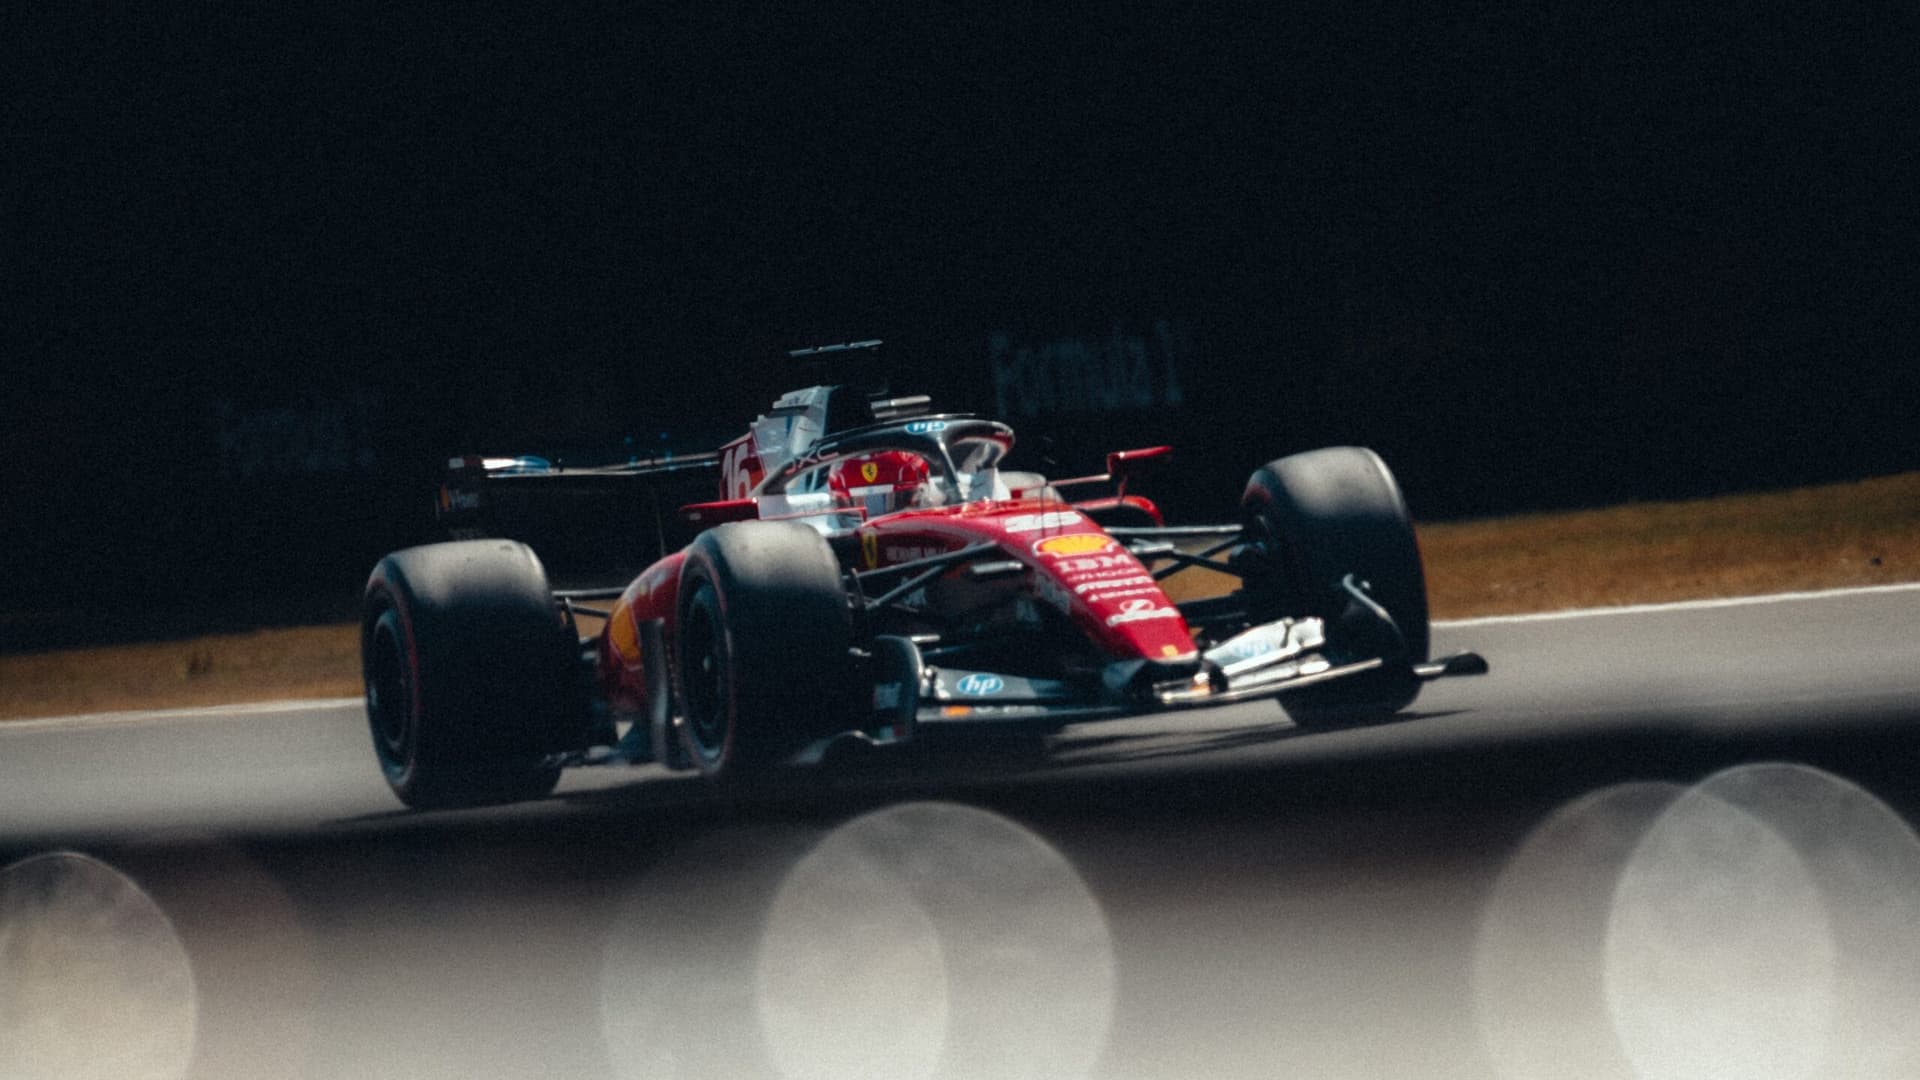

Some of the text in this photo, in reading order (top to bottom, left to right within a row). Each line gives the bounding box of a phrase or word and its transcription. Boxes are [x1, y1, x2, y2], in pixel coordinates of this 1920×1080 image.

[990, 320, 1153, 417] Formula
[722, 442, 753, 501] 16
[1053, 554, 1133, 574] IBM
[963, 673, 998, 697] hp
